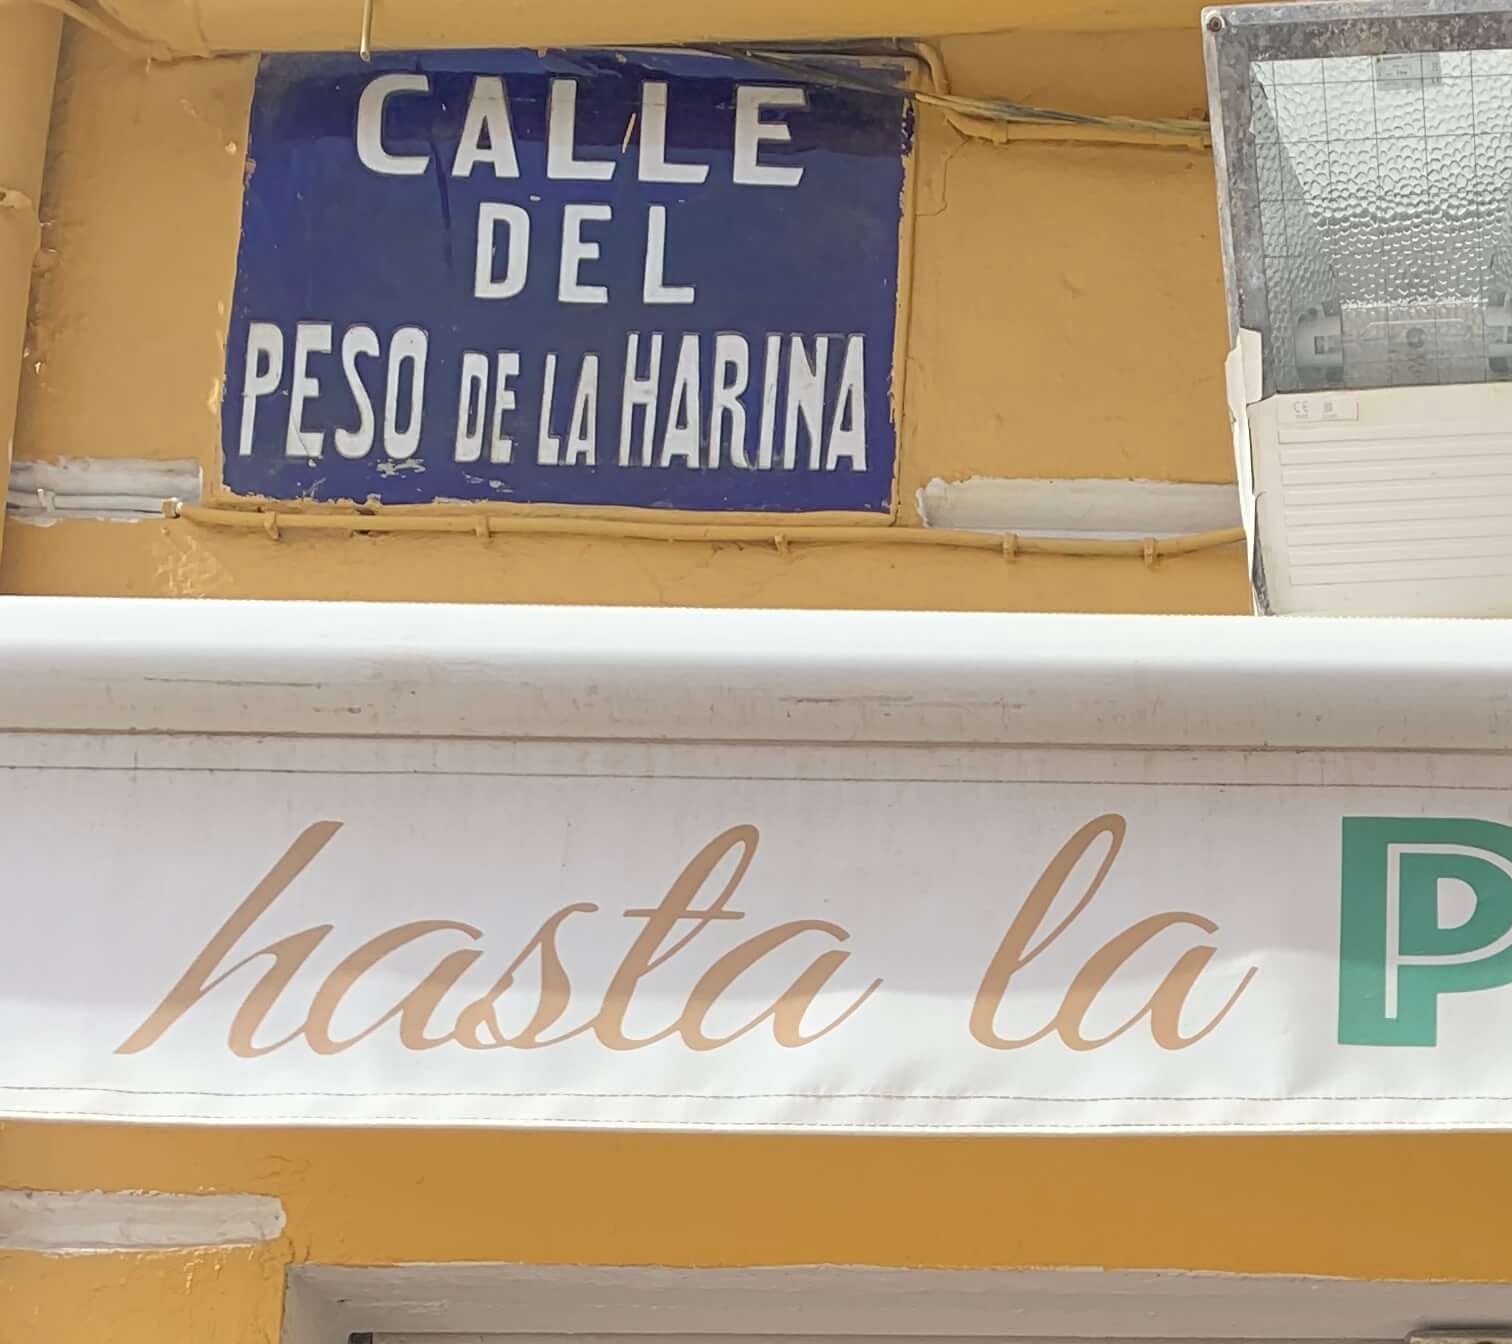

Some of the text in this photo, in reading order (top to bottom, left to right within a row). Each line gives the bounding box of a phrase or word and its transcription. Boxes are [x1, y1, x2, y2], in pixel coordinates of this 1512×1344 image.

[355, 73, 807, 187] CALLE
[474, 202, 695, 304] DEL
[239, 321, 868, 471] PESO DE LA HARINA
[114, 820, 884, 1059] hasta
[967, 813, 1258, 1051] la
